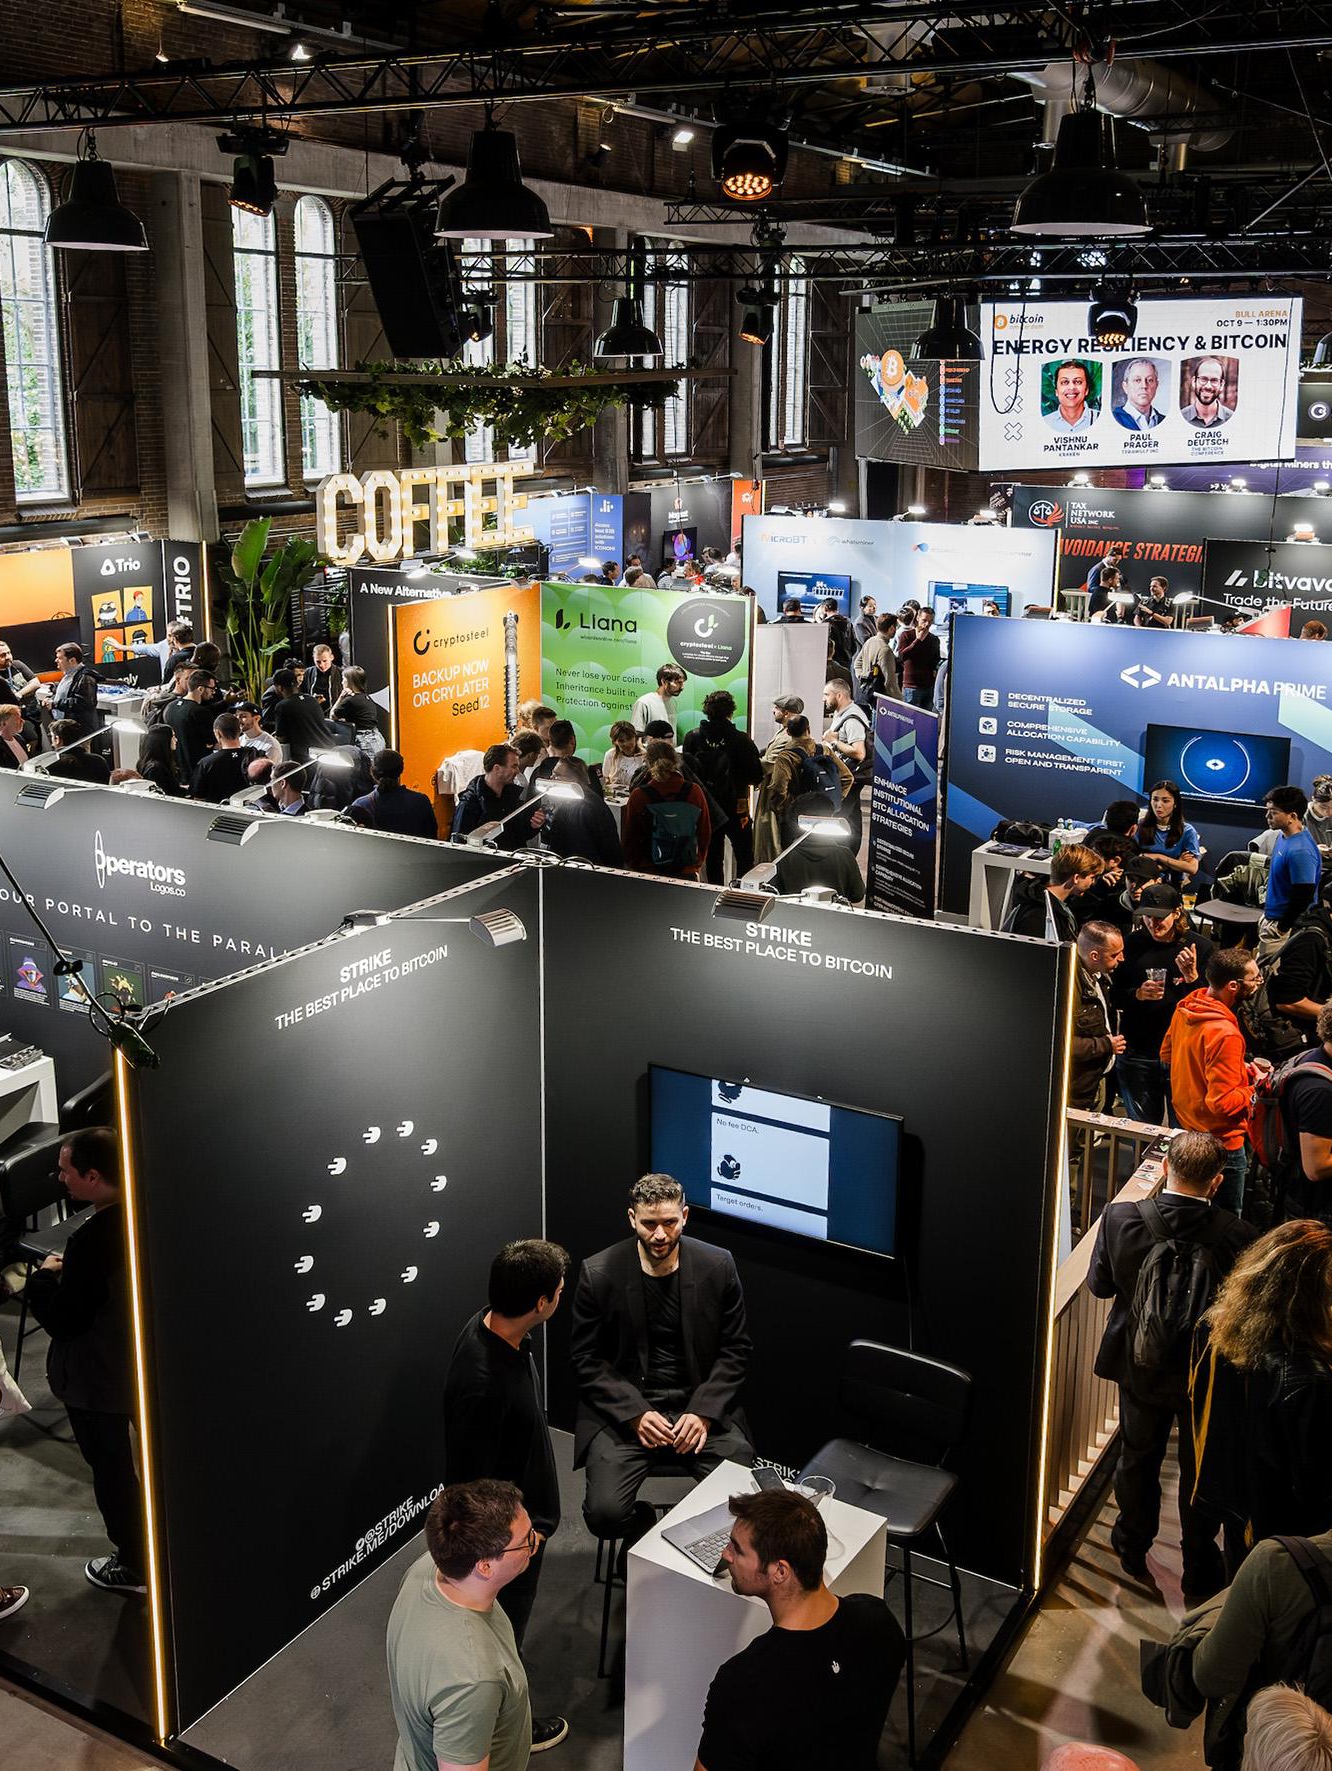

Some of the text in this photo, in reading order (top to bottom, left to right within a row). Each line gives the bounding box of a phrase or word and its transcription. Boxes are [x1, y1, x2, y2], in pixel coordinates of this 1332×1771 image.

[1010, 314, 1044, 324] bitcoin
[1258, 310, 1287, 318] ARENA
[994, 338, 1073, 355] ENERGY
[1194, 336, 1207, 350] &
[1211, 333, 1287, 350] BITCOIN
[1043, 444, 1099, 452] PANTANKAR
[1053, 436, 1088, 445] VISHNU
[1124, 441, 1159, 449] PRAGER
[1188, 439, 1229, 447] DEUTSCH
[316, 460, 535, 566] COFFEE
[1071, 502, 1087, 510] TAX
[1071, 509, 1115, 519] NETWORK
[1070, 517, 1087, 525] USA
[1133, 542, 1203, 563] STRATEGI
[117, 557, 140, 573] Trio
[360, 583, 392, 595] A New
[1223, 593, 1262, 608] Trade
[580, 613, 637, 633] Liana
[434, 628, 489, 649] cryptosteel
[413, 658, 489, 689] BACKUP NOW
[556, 669, 648, 684] Never lose your coins.
[413, 678, 489, 708] OR CRY LATER
[556, 682, 638, 698] Inheritance built in.
[1166, 672, 1327, 700] ANTALPHA PRIME
[556, 696, 633, 711] Protection against
[1008, 693, 1086, 706] DECENTRALIZED
[1008, 701, 1092, 716] SECURE STORAGE
[1007, 721, 1088, 735] COMPREHENSIVE
[1007, 729, 1120, 747] ALLOCATION CAPABILITY
[1005, 757, 1122, 776] OPEN AND TRANSPARENT
[1028, 751, 1095, 764] MANAGEMENT
[874, 776, 907, 796] ENHANCE
[873, 788, 923, 816] INSTITUTIONAL
[872, 800, 930, 832] BTC ALLOCATION
[872, 813, 913, 837] STRATEGIES
[94, 831, 186, 888] Operators
[150, 881, 186, 897] Logos.co
[45, 898, 118, 926] PORTAL
[128, 916, 152, 933] TO
[163, 924, 200, 944] THE
[212, 934, 291, 962] PARAL
[745, 922, 812, 947] STRIKE
[670, 927, 893, 980] THE BEST PLACE TO BITCOIN
[340, 948, 392, 983] STRIKE
[275, 945, 448, 1030] THE BEST PLACE TO BITCOIN
[716, 1117, 759, 1135] No fee DCA.
[716, 1193, 763, 1213] Target orders.
[752, 1457, 800, 1479] STRIK
[365, 1496, 413, 1543] @STRIKE
[322, 1483, 445, 1591] STRIKE.ME/DOWNLOA
